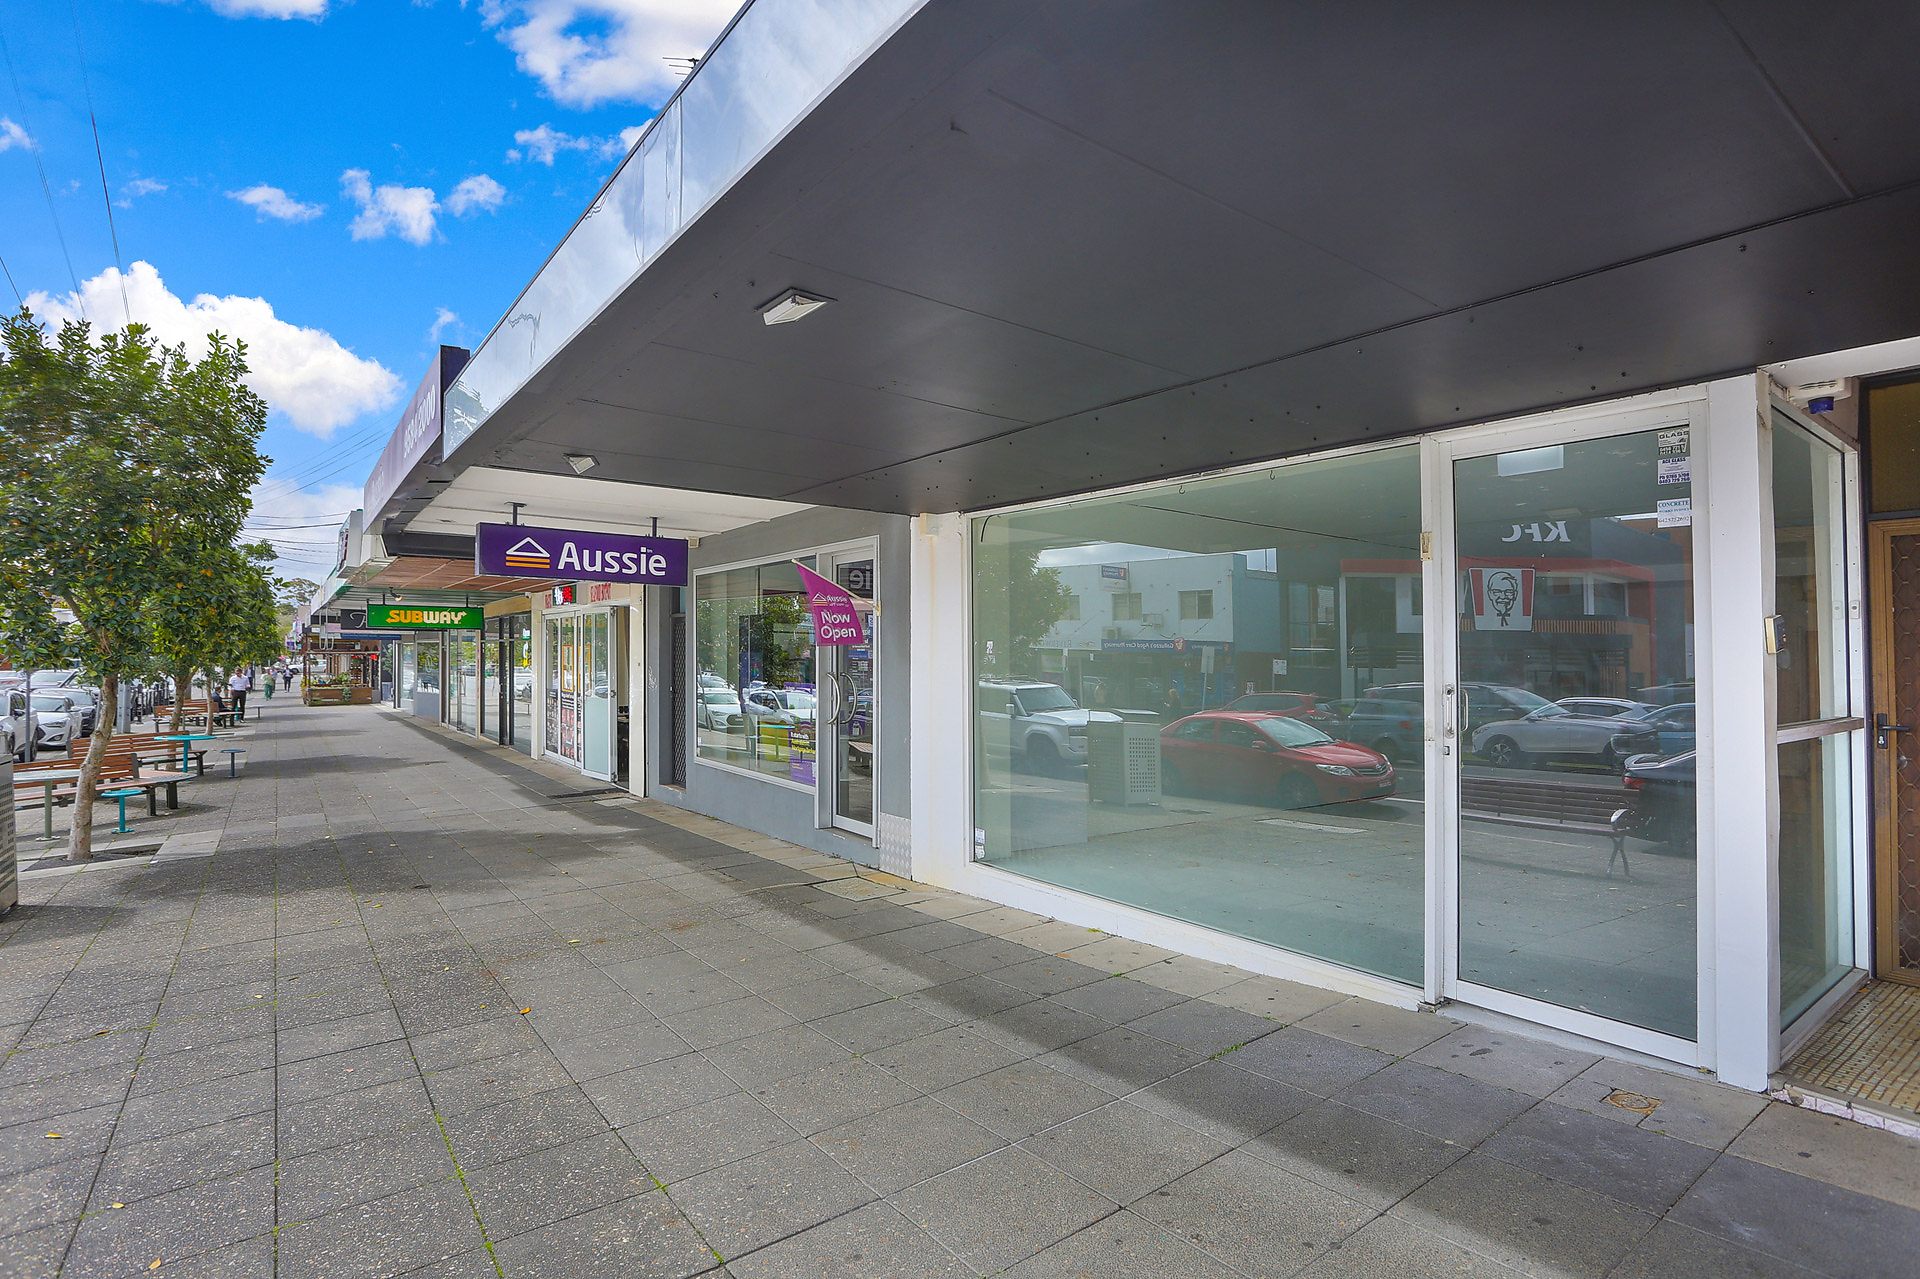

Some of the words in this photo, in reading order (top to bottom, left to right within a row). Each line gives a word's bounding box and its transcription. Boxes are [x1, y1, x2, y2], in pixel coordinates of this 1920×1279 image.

[1659, 430, 1689, 440] GLASS
[1658, 500, 1689, 508] CONCRETE
[557, 541, 667, 576] Aussie
[386, 609, 468, 625] SUBWAY
[821, 611, 850, 624] Now
[821, 625, 857, 642] Open
